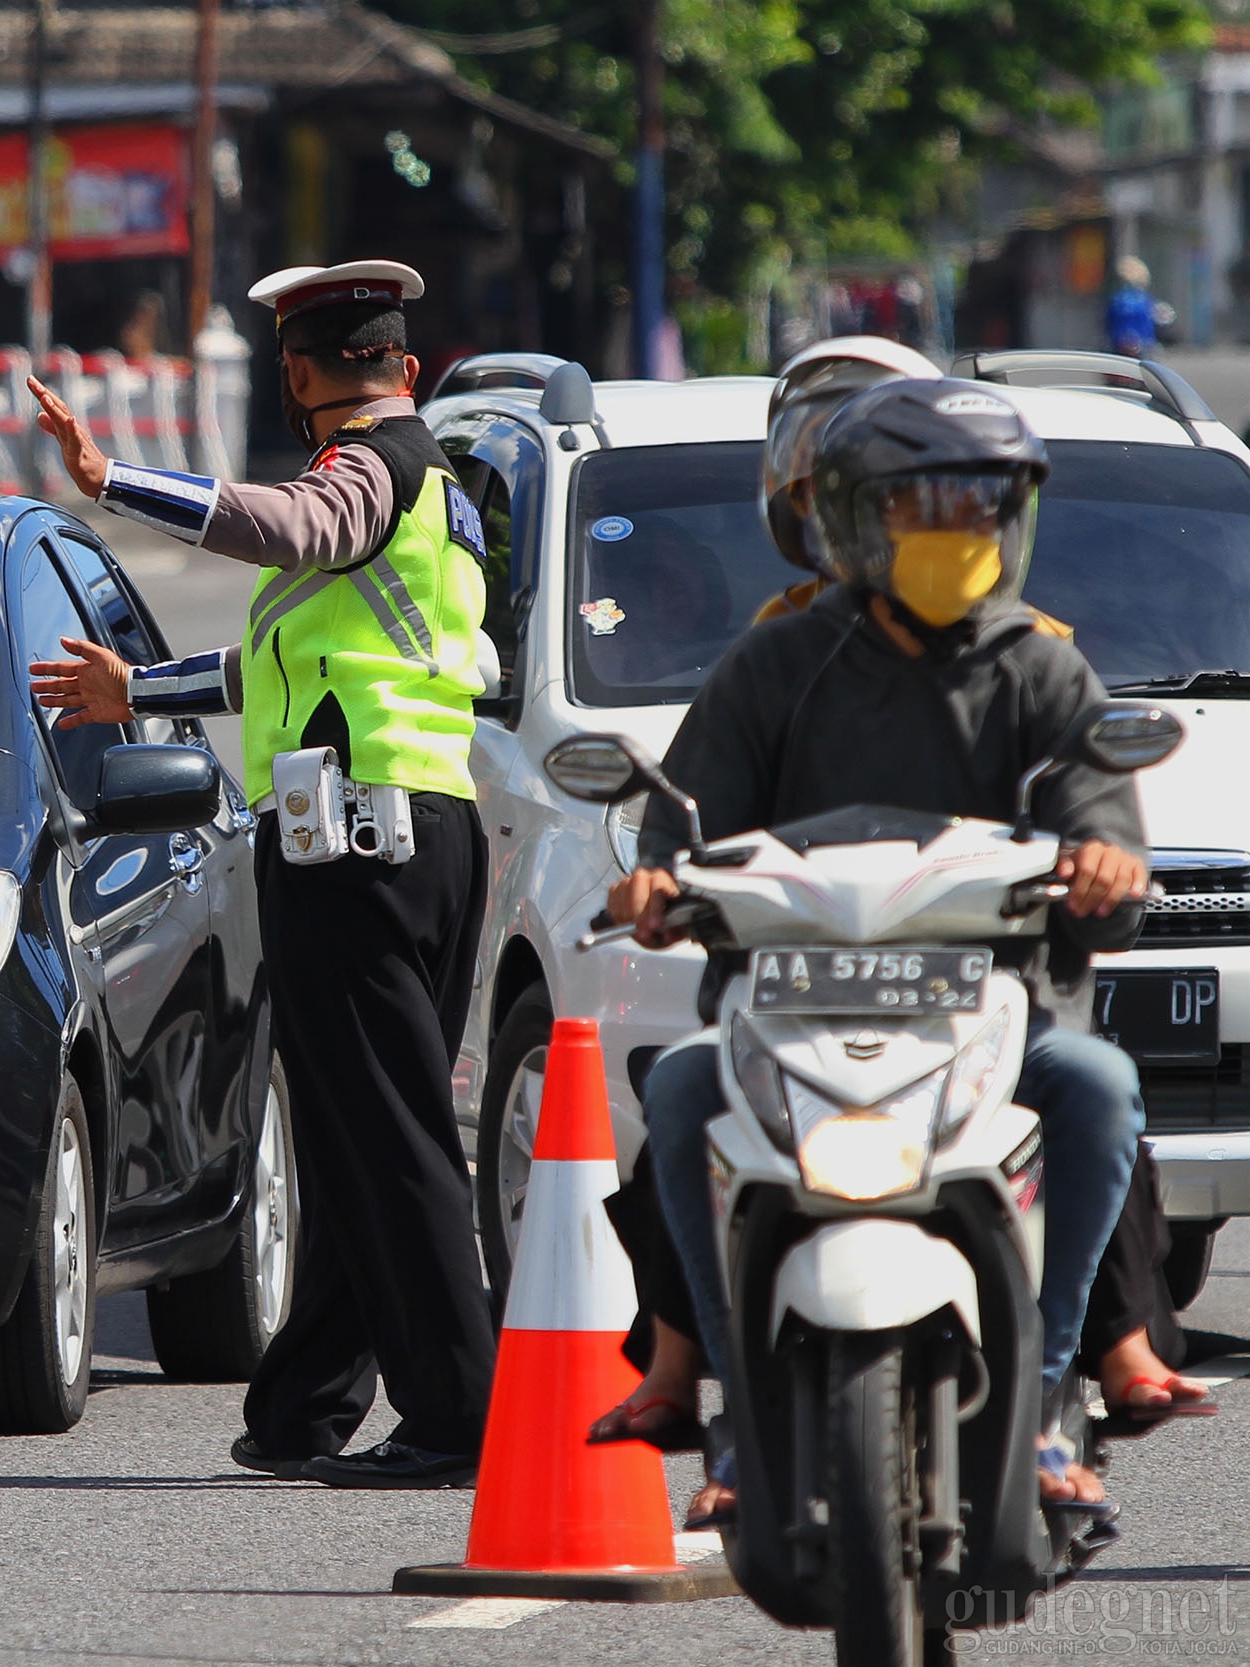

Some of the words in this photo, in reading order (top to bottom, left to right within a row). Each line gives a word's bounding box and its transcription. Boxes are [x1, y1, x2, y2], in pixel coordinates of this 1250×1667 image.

[830, 953, 924, 981] 5756
[961, 953, 985, 982] C
[1171, 980, 1216, 1025] DP
